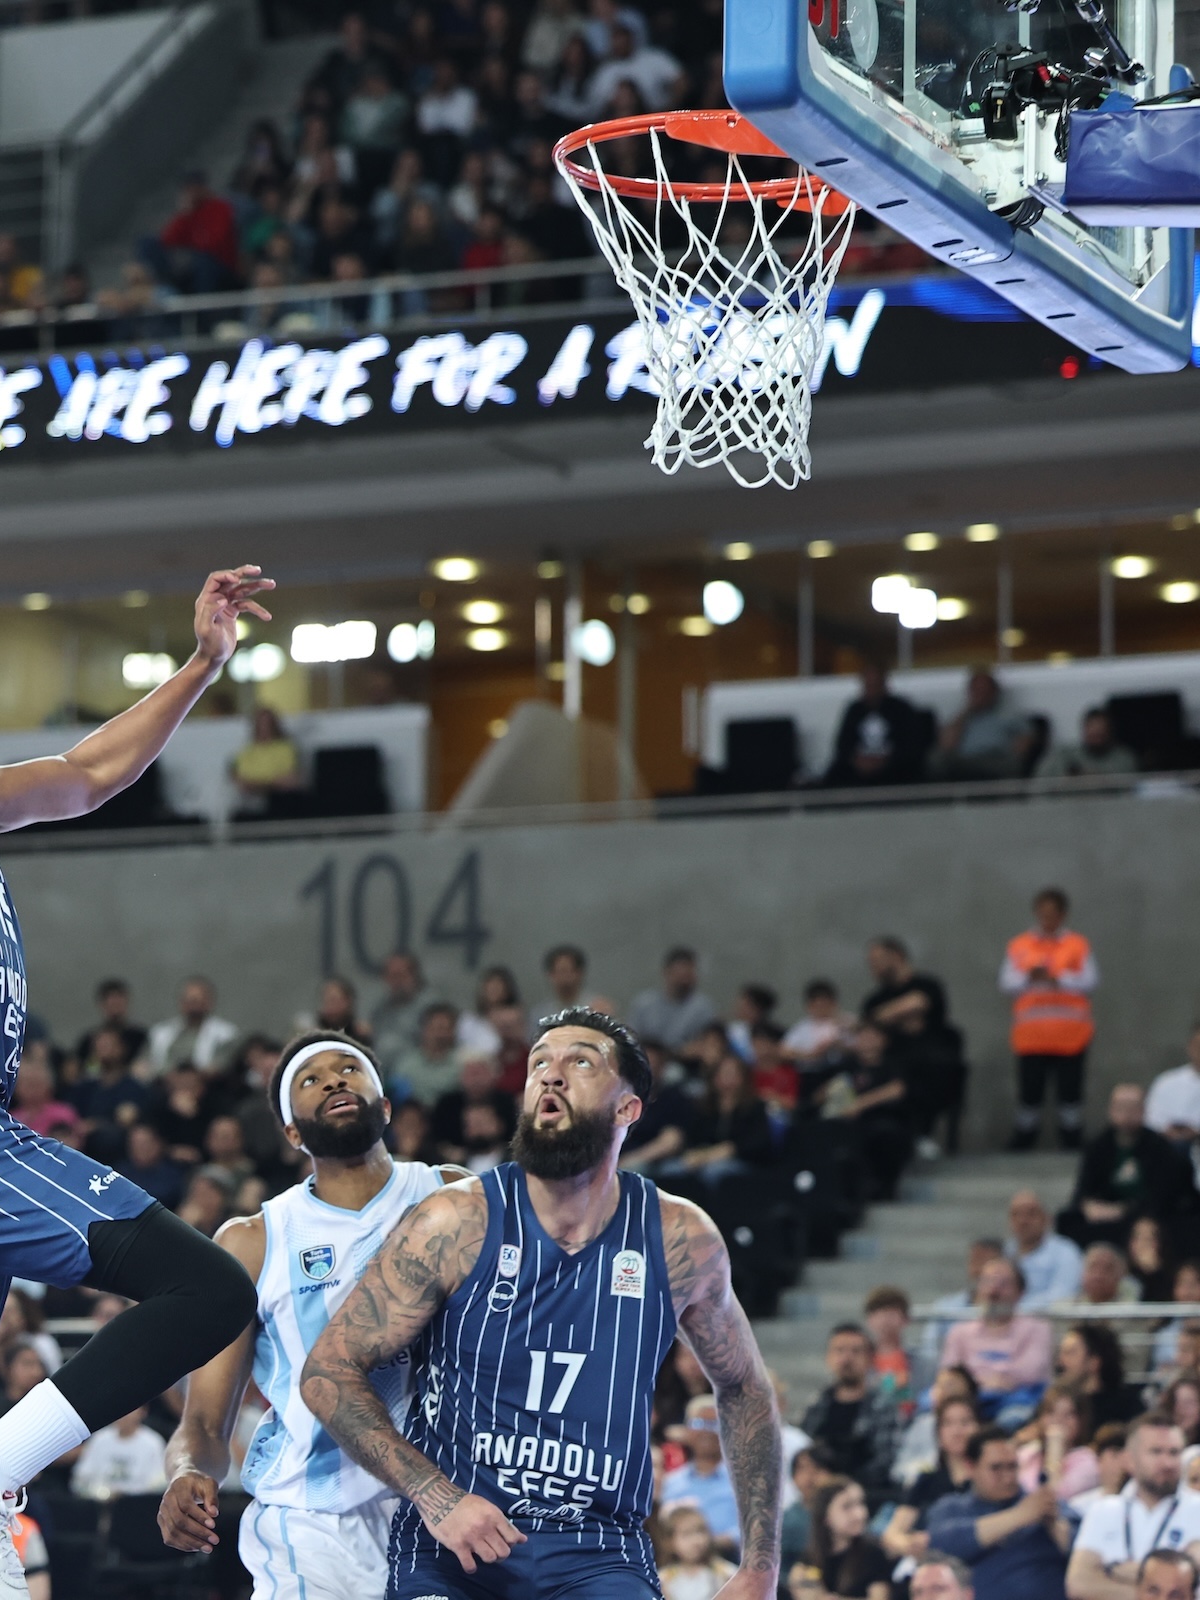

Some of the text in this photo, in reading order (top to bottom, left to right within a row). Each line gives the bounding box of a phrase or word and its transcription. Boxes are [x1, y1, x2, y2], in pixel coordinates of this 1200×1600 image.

[189, 335, 390, 448] HERE
[391, 332, 527, 414] FOR
[298, 852, 491, 977] 104
[524, 1350, 587, 1414] 17
[475, 1433, 623, 1491] ANADOLU
[497, 1468, 597, 1509] EFES
